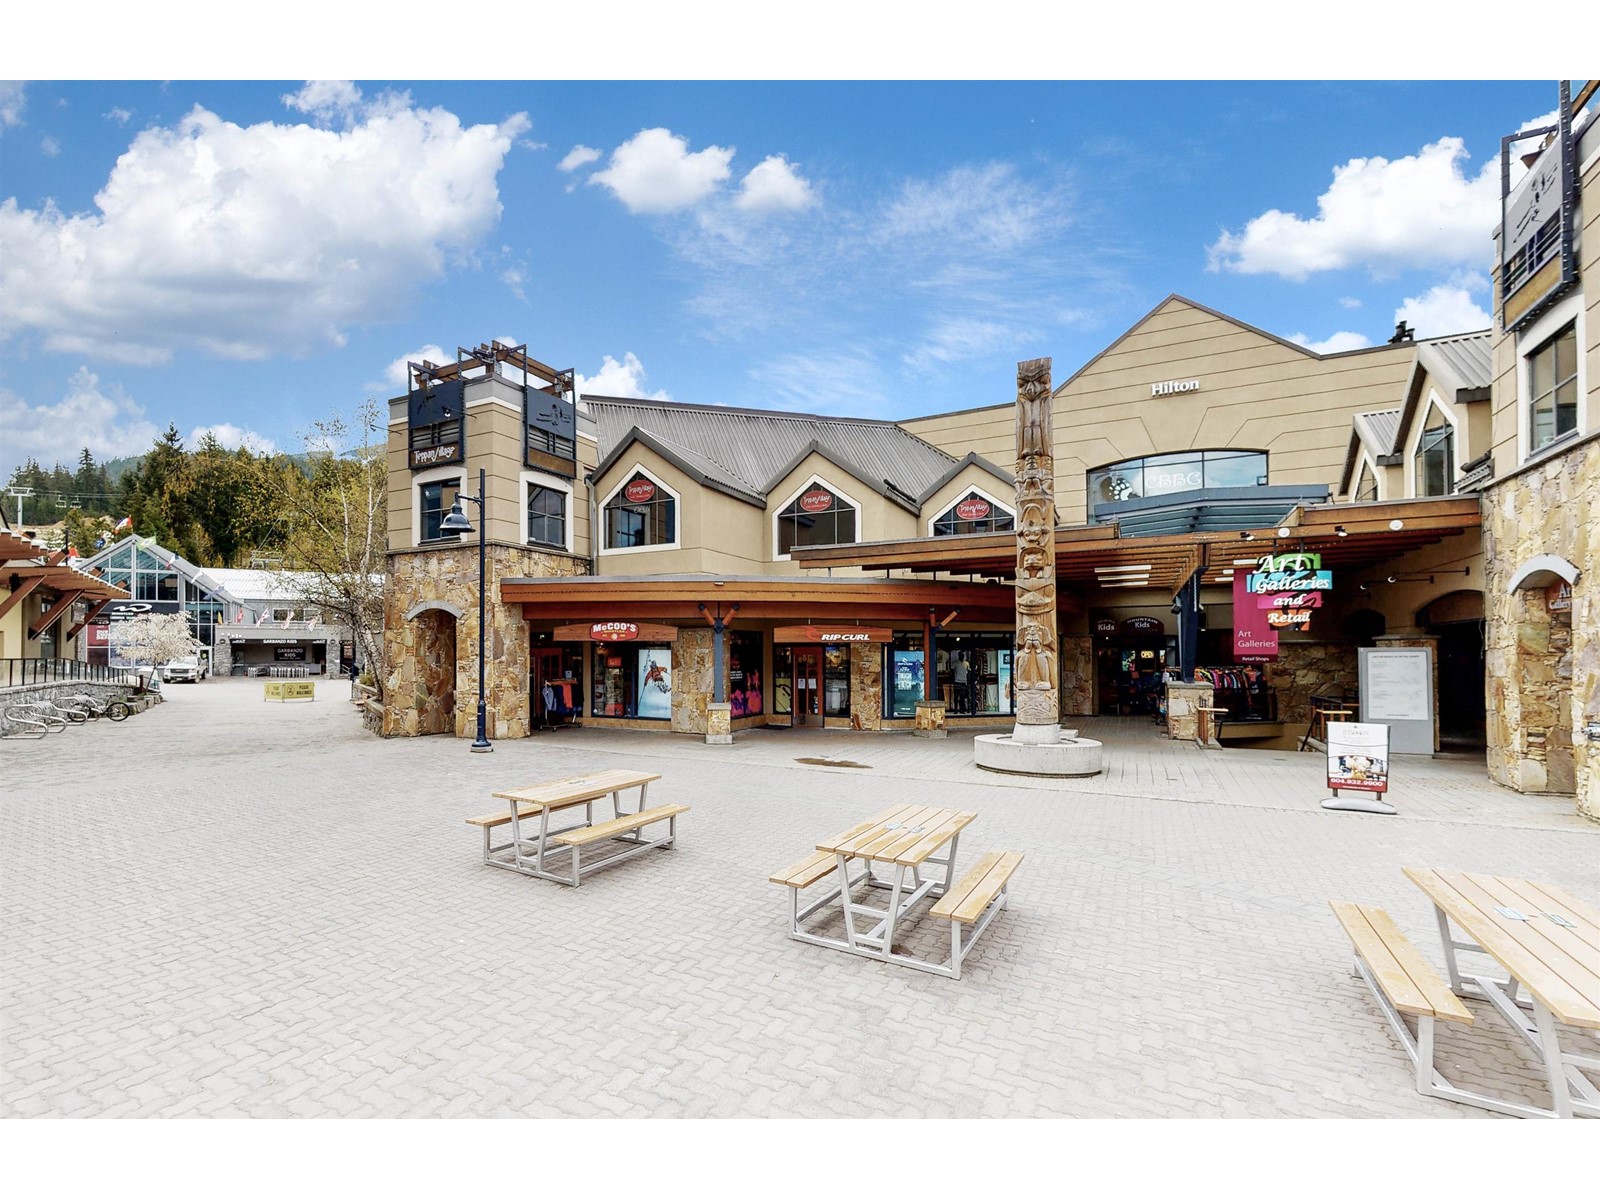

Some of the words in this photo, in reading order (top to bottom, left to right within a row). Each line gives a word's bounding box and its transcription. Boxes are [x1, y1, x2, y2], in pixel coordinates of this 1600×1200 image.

[1151, 380, 1200, 396] Hilton
[1252, 553, 1305, 574] Art
[1255, 572, 1330, 594] Galleries
[1273, 593, 1307, 606] and
[1267, 610, 1313, 624] Retail
[1097, 623, 1115, 631] Kids
[821, 633, 842, 641] RIP
[841, 633, 870, 641] CURL
[1238, 630, 1251, 638] Art
[1238, 640, 1276, 648] Galleries
